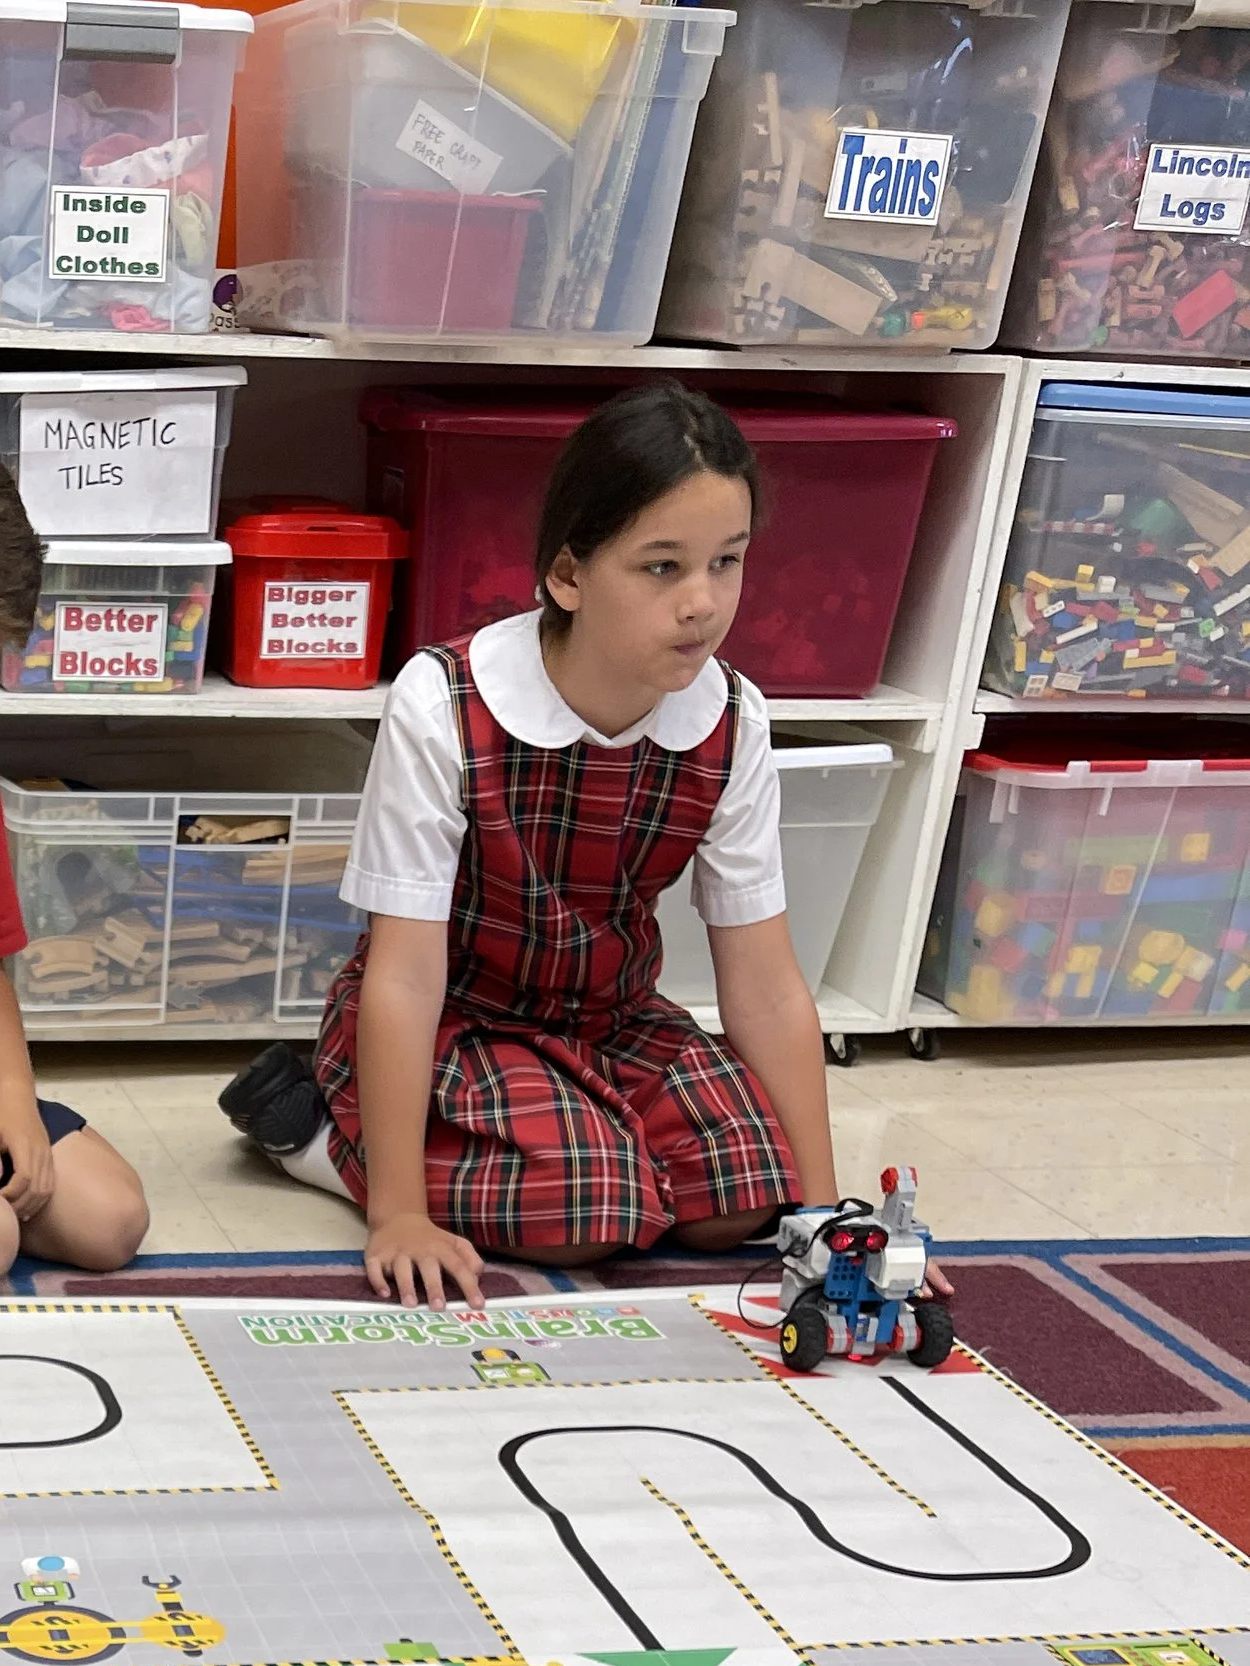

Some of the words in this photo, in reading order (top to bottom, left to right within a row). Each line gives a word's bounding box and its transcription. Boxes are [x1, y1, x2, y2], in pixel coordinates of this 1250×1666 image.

[412, 113, 446, 145] FREE
[412, 140, 445, 171] PAPER
[1151, 149, 1250, 179] Lincoln
[837, 134, 940, 217] Trains
[62, 194, 147, 214] Inside
[1159, 193, 1226, 226] Logs
[76, 225, 129, 244] Doll
[56, 255, 159, 275] Clothes
[44, 416, 177, 450] MAGNETIC
[57, 462, 124, 490] TILES
[267, 587, 358, 605] Bigger
[64, 607, 159, 633] Better
[271, 613, 358, 629] Better
[267, 638, 359, 654] Blocks
[60, 651, 159, 676] Blocks
[239, 1313, 447, 1329] EDUCATION
[454, 1307, 551, 1323] STEM
[250, 1316, 665, 1347] BrainStorm
